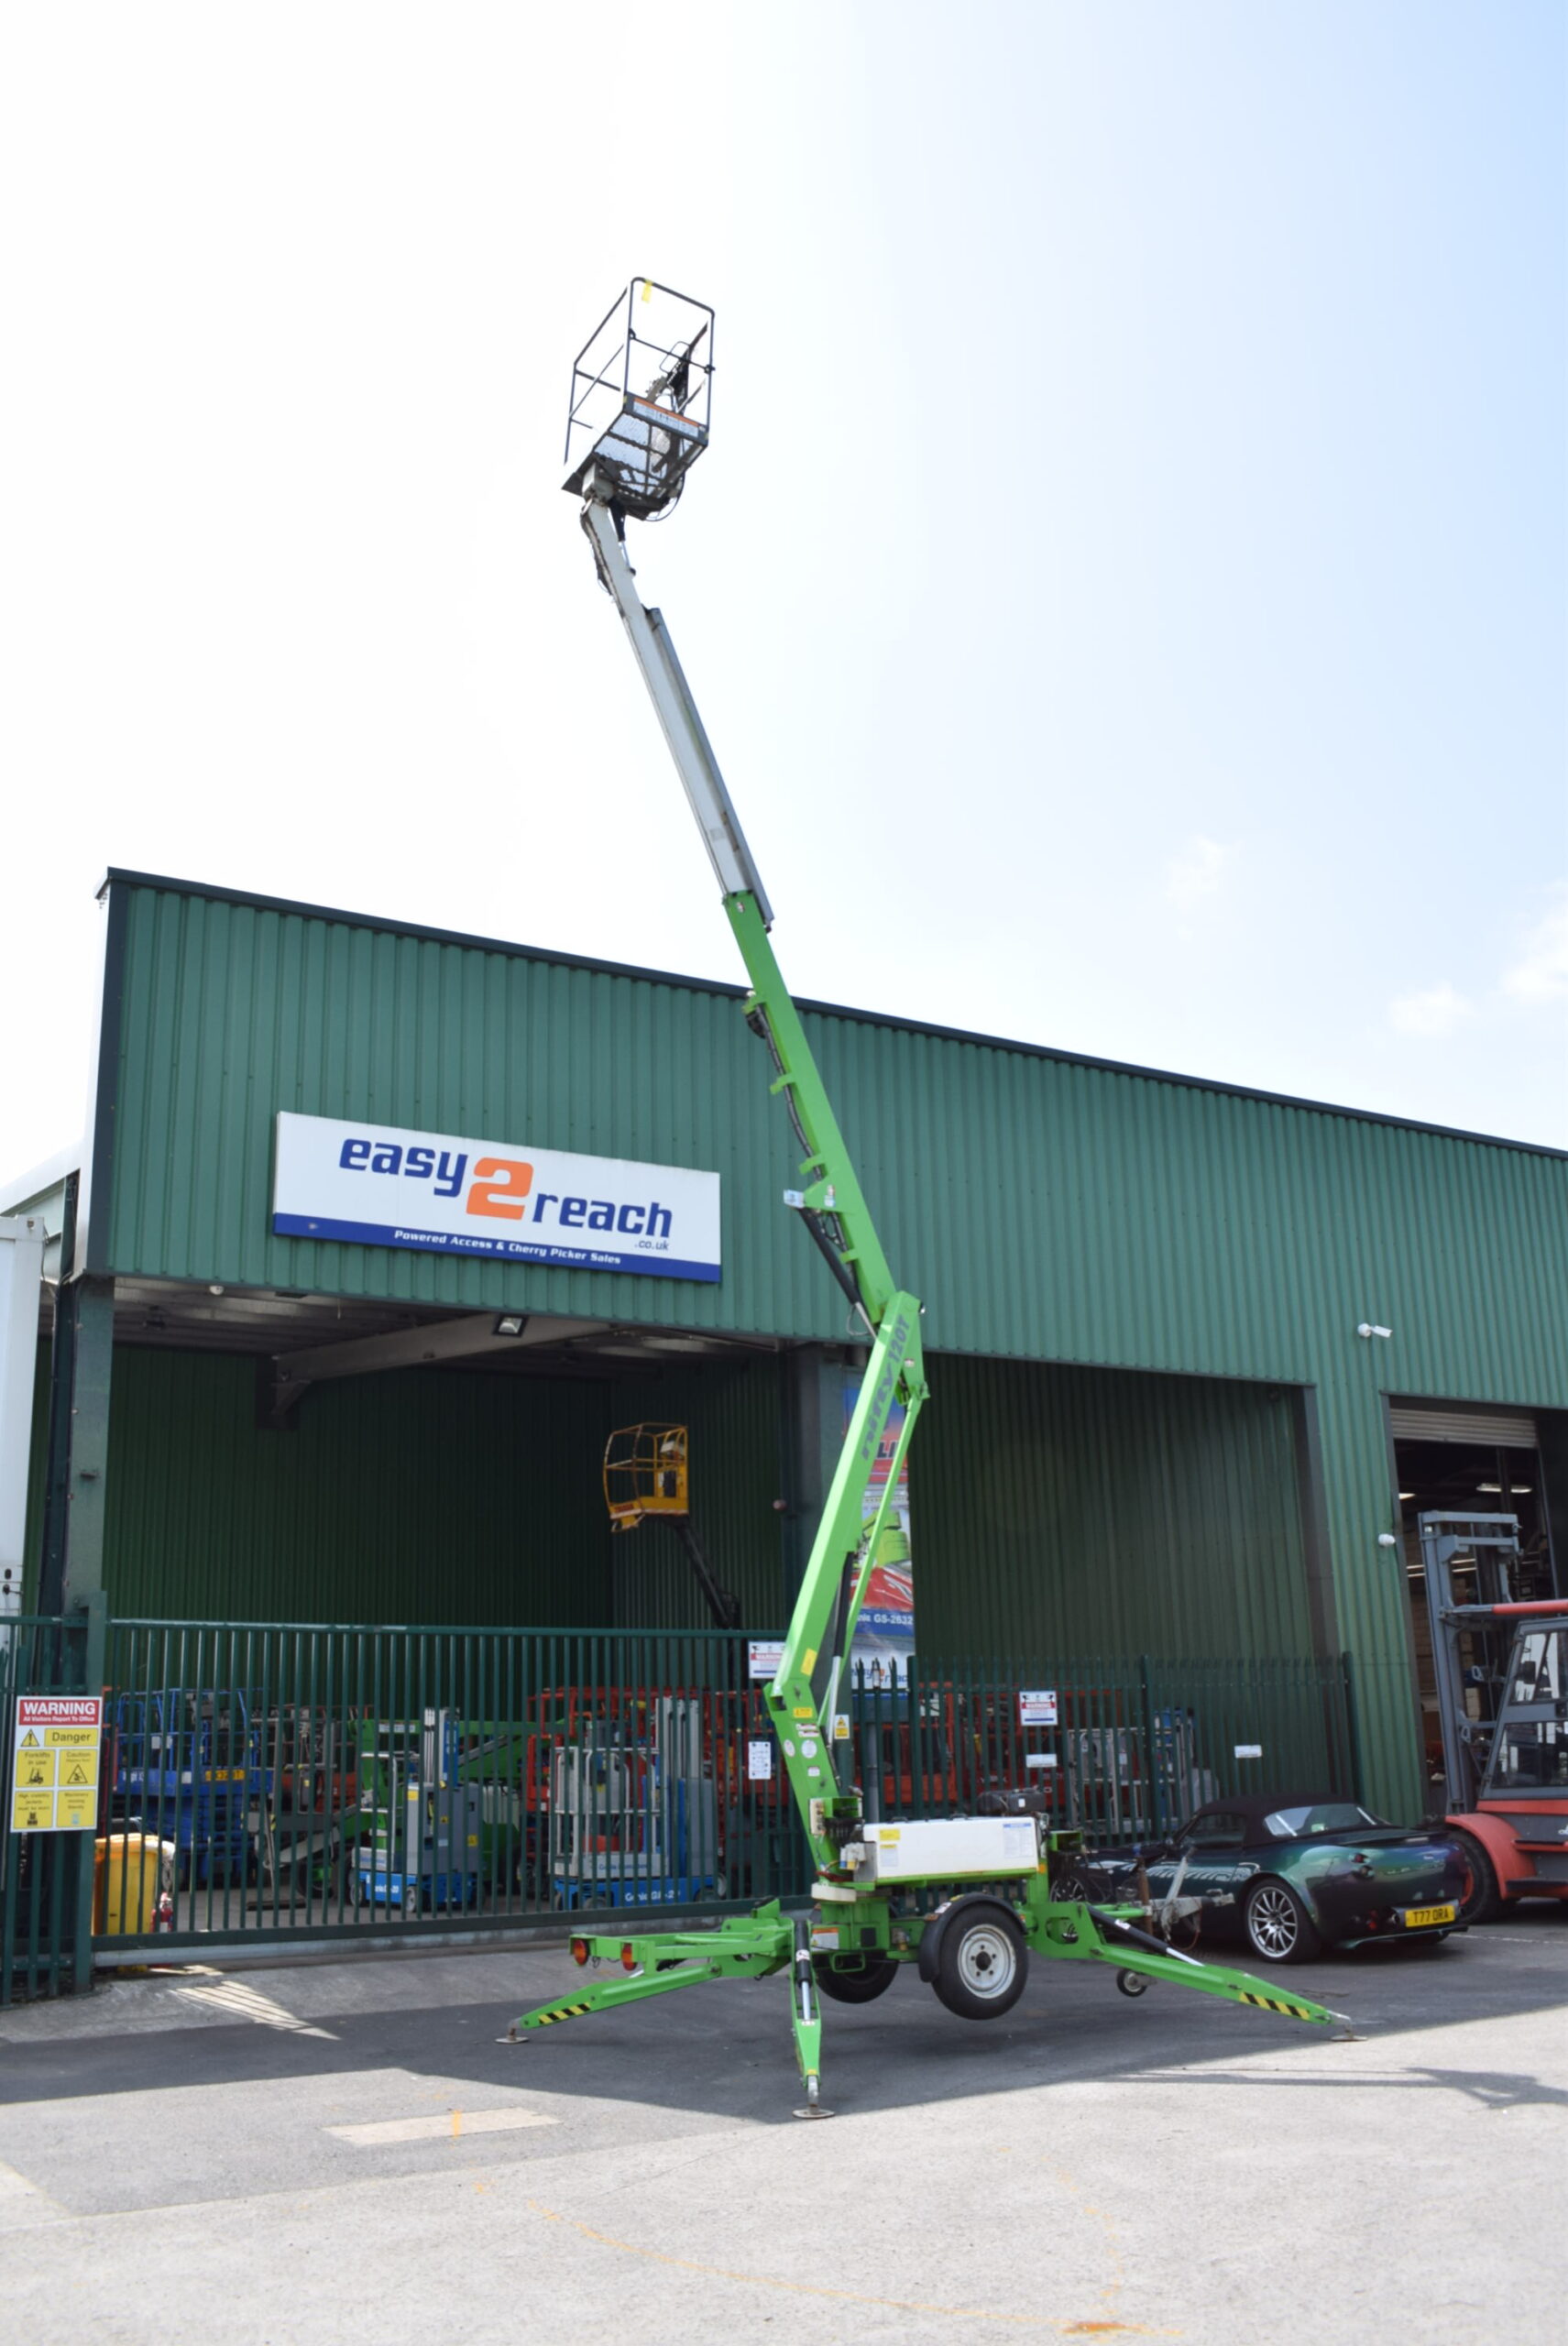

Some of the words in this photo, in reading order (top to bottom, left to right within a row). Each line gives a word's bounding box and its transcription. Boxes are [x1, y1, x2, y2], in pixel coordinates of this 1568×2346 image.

[394, 1230, 446, 1244] Powered
[450, 1236, 493, 1249] Access
[496, 1241, 504, 1251] &
[509, 1243, 547, 1257] Cherry
[550, 1247, 587, 1261] Picker
[590, 1253, 621, 1265] Sales
[23, 1702, 95, 1715] WARNING
[51, 1731, 91, 1744] Danger
[1413, 1910, 1431, 1924] T77
